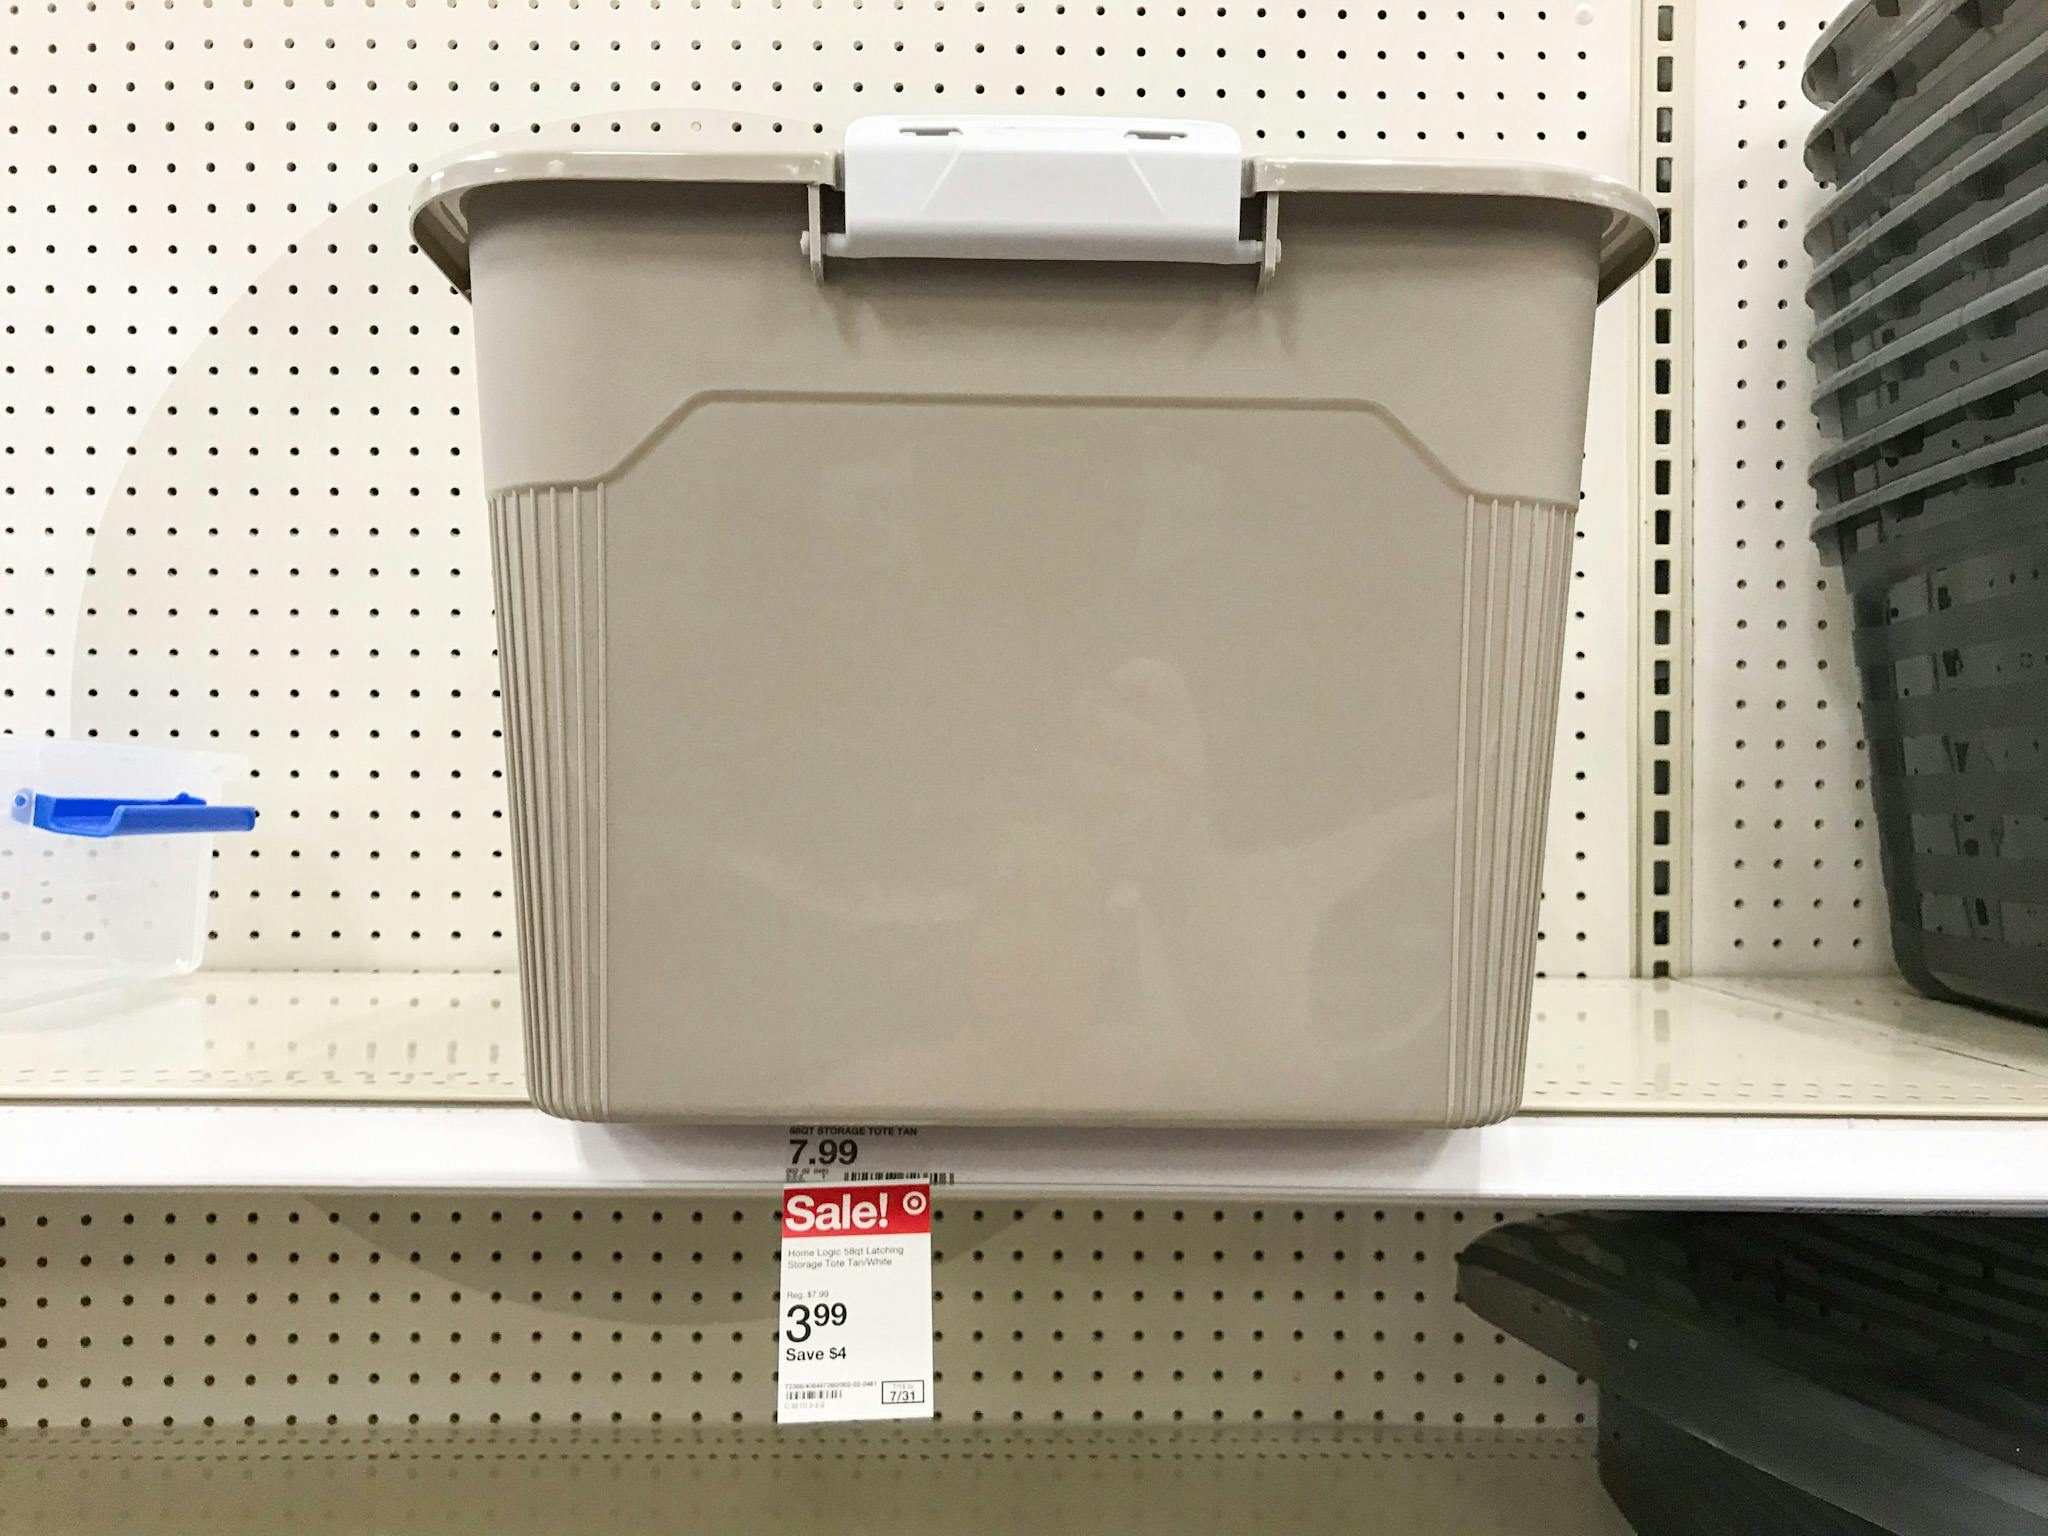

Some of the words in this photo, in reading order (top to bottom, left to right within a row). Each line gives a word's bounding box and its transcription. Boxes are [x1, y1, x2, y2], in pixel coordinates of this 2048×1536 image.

[818, 1126, 865, 1136] STORAGE
[868, 1126, 894, 1136] TOTE
[898, 1126, 918, 1136] TAN
[789, 1139, 858, 1165] 7.99
[785, 1192, 888, 1232] Sale!
[788, 1249, 814, 1257] Home
[817, 1247, 841, 1258] Logic
[866, 1245, 904, 1256] Latching
[787, 1260, 822, 1270] Storage
[825, 1259, 845, 1268] Tote
[848, 1257, 892, 1267] Tan/White
[786, 1347, 824, 1361] Save
[829, 1346, 847, 1360] $4
[890, 1390, 916, 1402] 7/31
